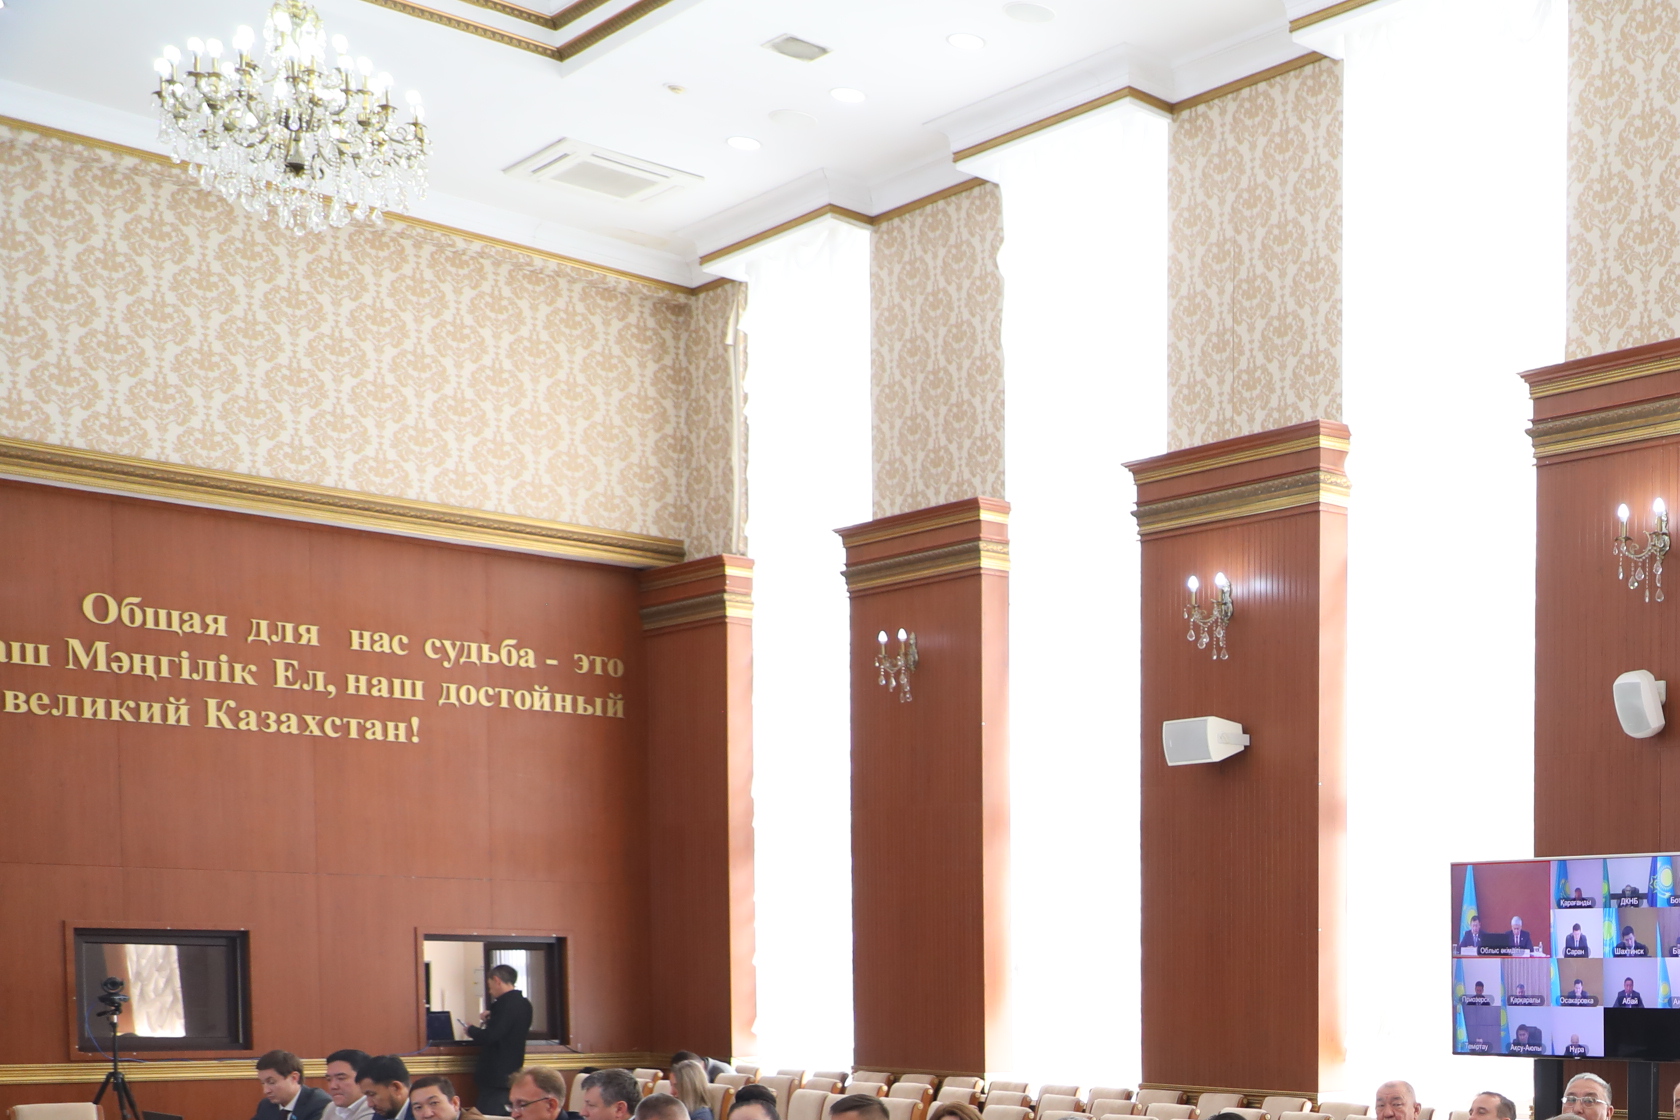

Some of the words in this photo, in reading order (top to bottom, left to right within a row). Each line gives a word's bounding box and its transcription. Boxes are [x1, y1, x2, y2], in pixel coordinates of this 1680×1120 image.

[83, 592, 229, 637] Общая
[248, 618, 321, 647] для
[350, 630, 410, 656] нас
[424, 637, 537, 671] судьба
[573, 653, 625, 678] это
[64, 637, 259, 686] Мәңгілік
[272, 658, 338, 699] Ел,
[346, 674, 426, 701] наш
[438, 681, 626, 718] достойный
[3, 690, 191, 727] великий
[204, 697, 421, 744] Казахстан!
[1566, 948, 1585, 956] Саран
[1622, 997, 1639, 1005] Абай
